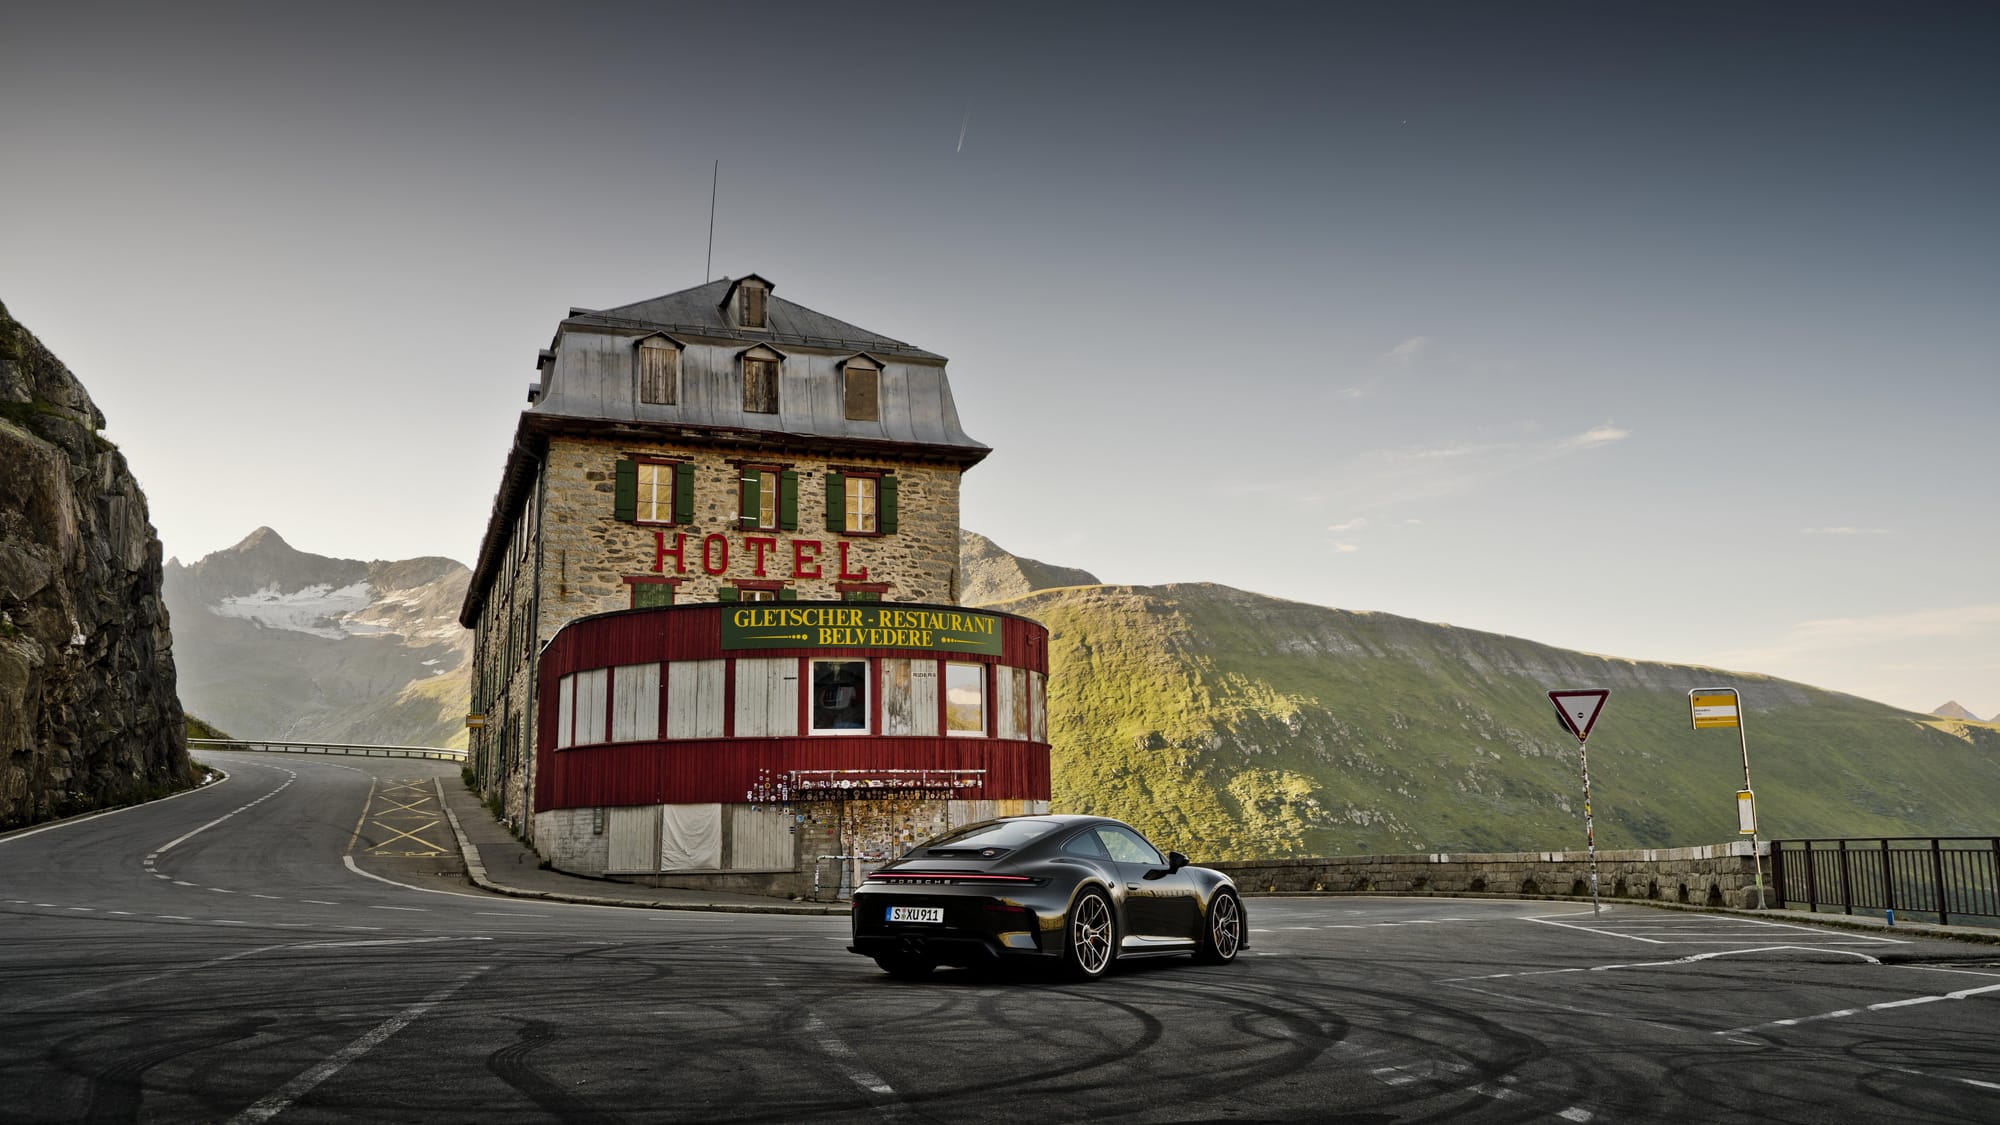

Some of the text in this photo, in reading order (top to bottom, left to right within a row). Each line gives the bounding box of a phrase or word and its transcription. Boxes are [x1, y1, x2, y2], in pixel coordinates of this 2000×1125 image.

[653, 531, 868, 580] HOTEL
[733, 608, 864, 628] GLETSCHER
[878, 609, 995, 635] RESTAURANT
[818, 628, 934, 647] BELVEDERE
